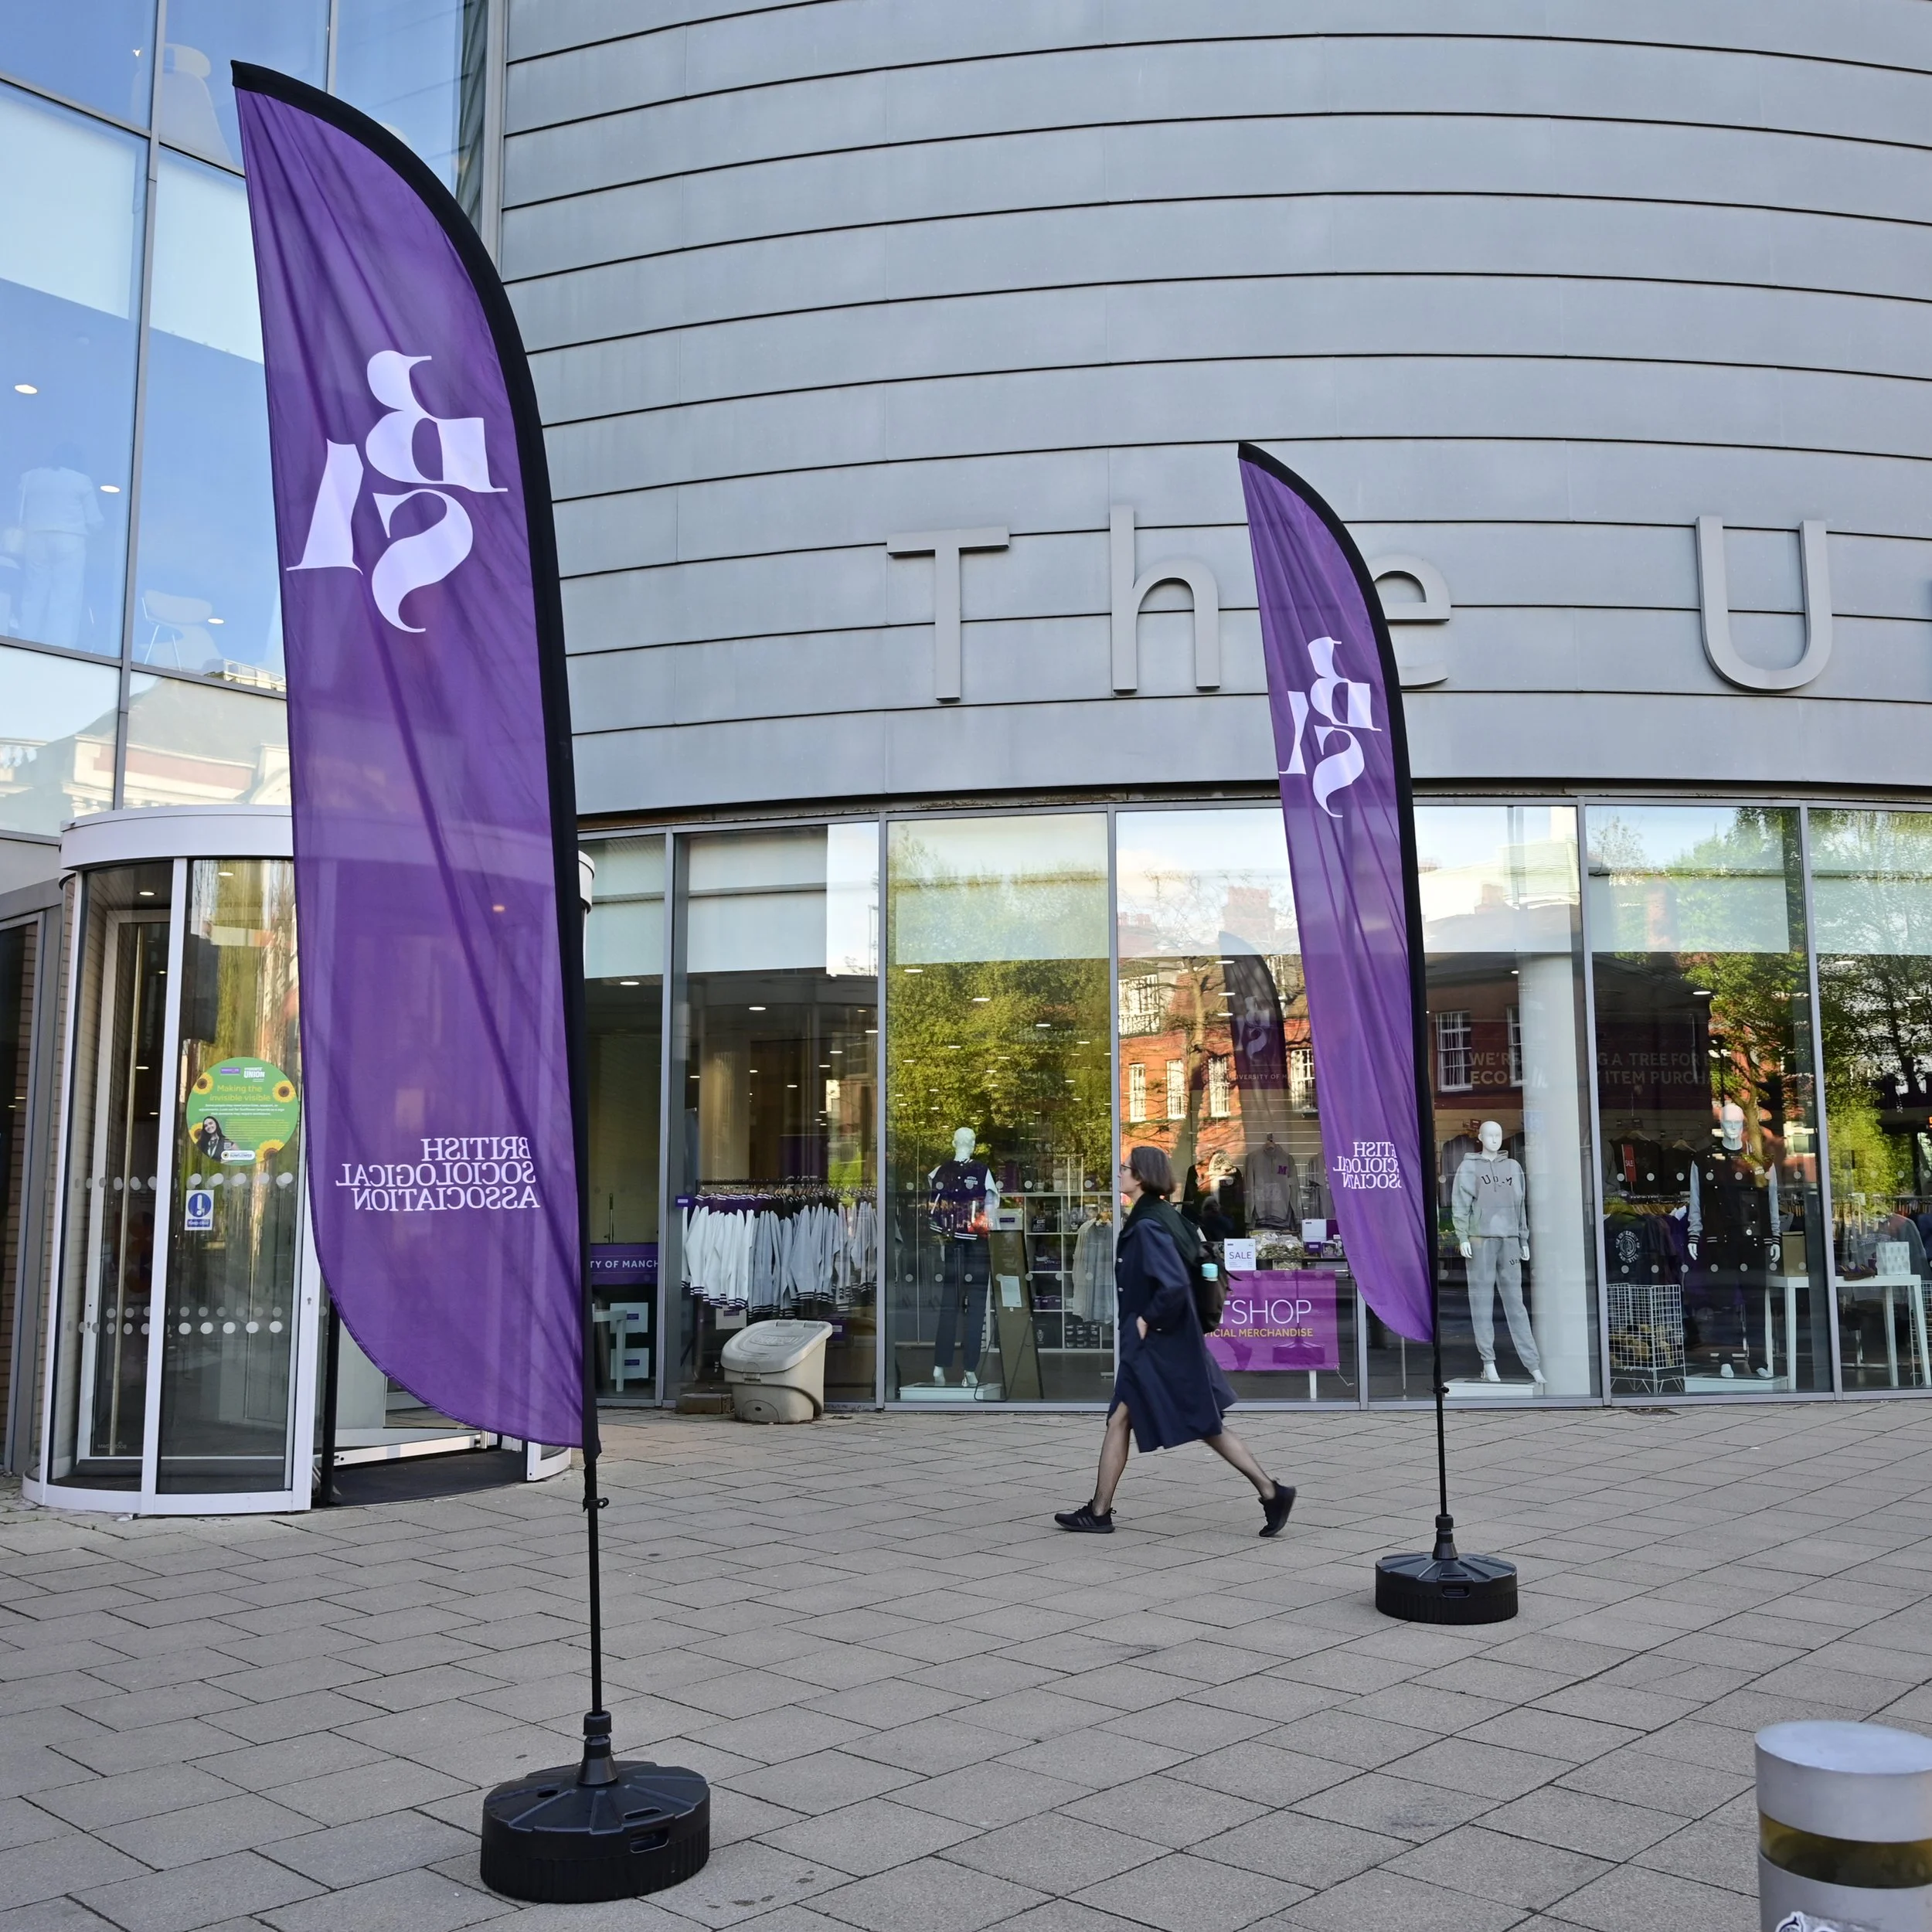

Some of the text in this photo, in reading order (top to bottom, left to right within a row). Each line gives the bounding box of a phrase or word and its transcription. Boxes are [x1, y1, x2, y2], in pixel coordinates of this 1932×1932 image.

[1629, 1053, 1669, 1066] TREE
[1605, 1071, 1645, 1084] ITEM
[217, 1085, 246, 1094] Making
[1229, 1251, 1252, 1260] SALE
[605, 1260, 619, 1269] OF
[1238, 1328, 1314, 1338] MERCHANDISE
